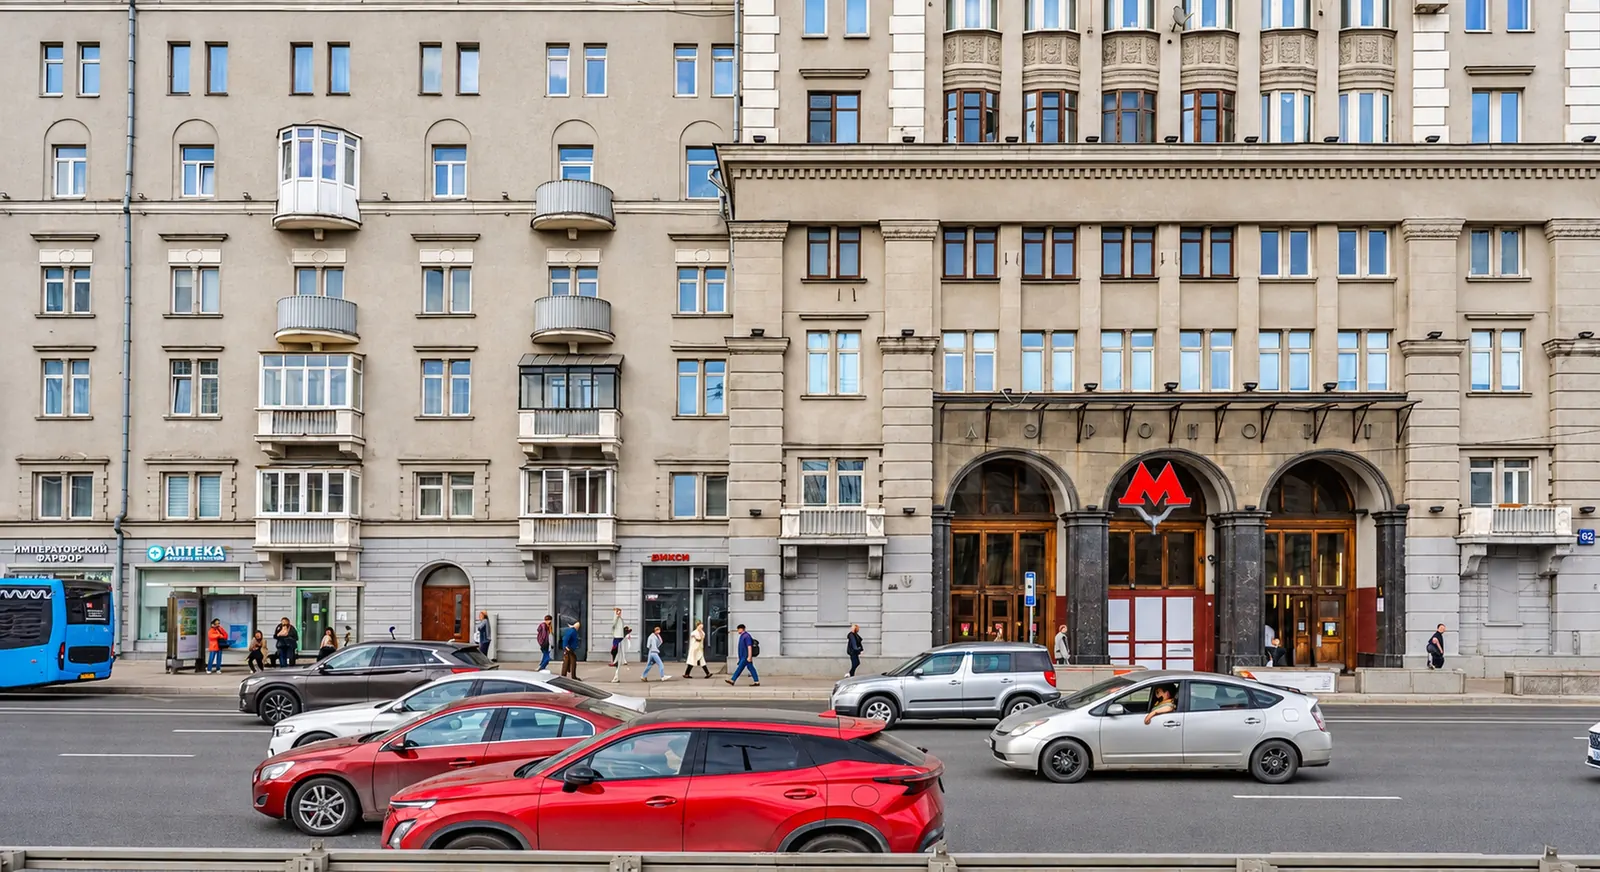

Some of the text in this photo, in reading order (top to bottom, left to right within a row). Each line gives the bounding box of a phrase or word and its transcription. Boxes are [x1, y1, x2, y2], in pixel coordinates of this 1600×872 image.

[1118, 461, 1192, 506] М
[1581, 532, 1594, 541] 62
[13, 543, 108, 554] ИМПЕРАТОРСКИЙ
[165, 546, 224, 556] АПТЕКА
[36, 554, 83, 562] ФАРФОР
